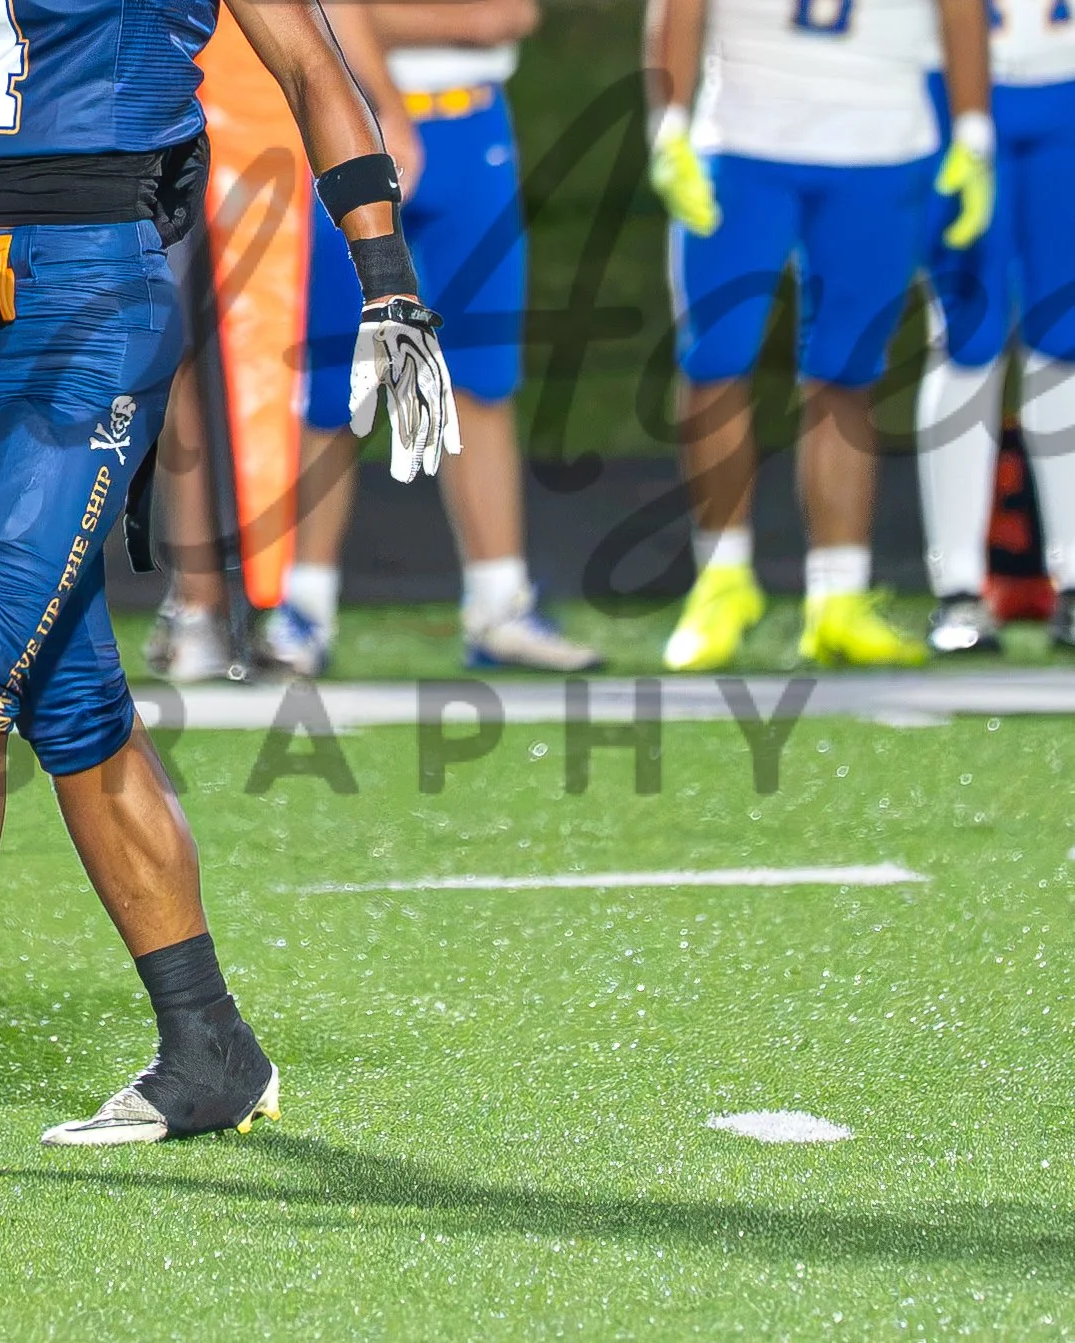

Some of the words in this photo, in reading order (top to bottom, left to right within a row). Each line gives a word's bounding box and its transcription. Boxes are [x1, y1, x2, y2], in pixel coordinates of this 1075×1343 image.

[35, 596, 61, 636] UP
[57, 535, 90, 593] THE
[81, 465, 112, 533] SHIP
